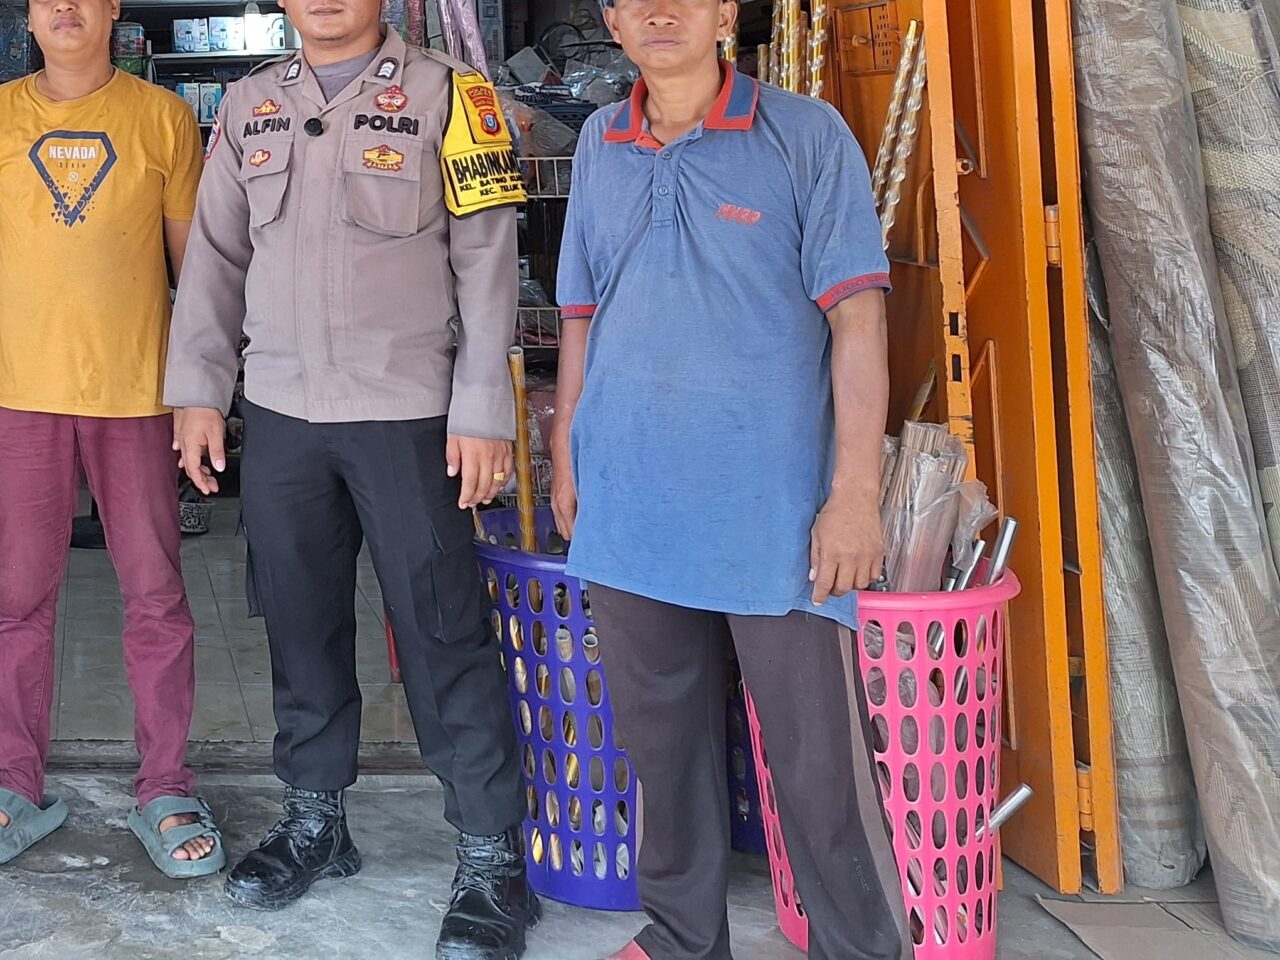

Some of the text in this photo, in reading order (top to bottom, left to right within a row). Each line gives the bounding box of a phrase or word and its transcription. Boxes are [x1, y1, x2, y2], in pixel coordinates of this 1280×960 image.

[243, 117, 291, 139] ALFIN
[353, 114, 419, 136] POLRI
[48, 145, 96, 159] NEVADA
